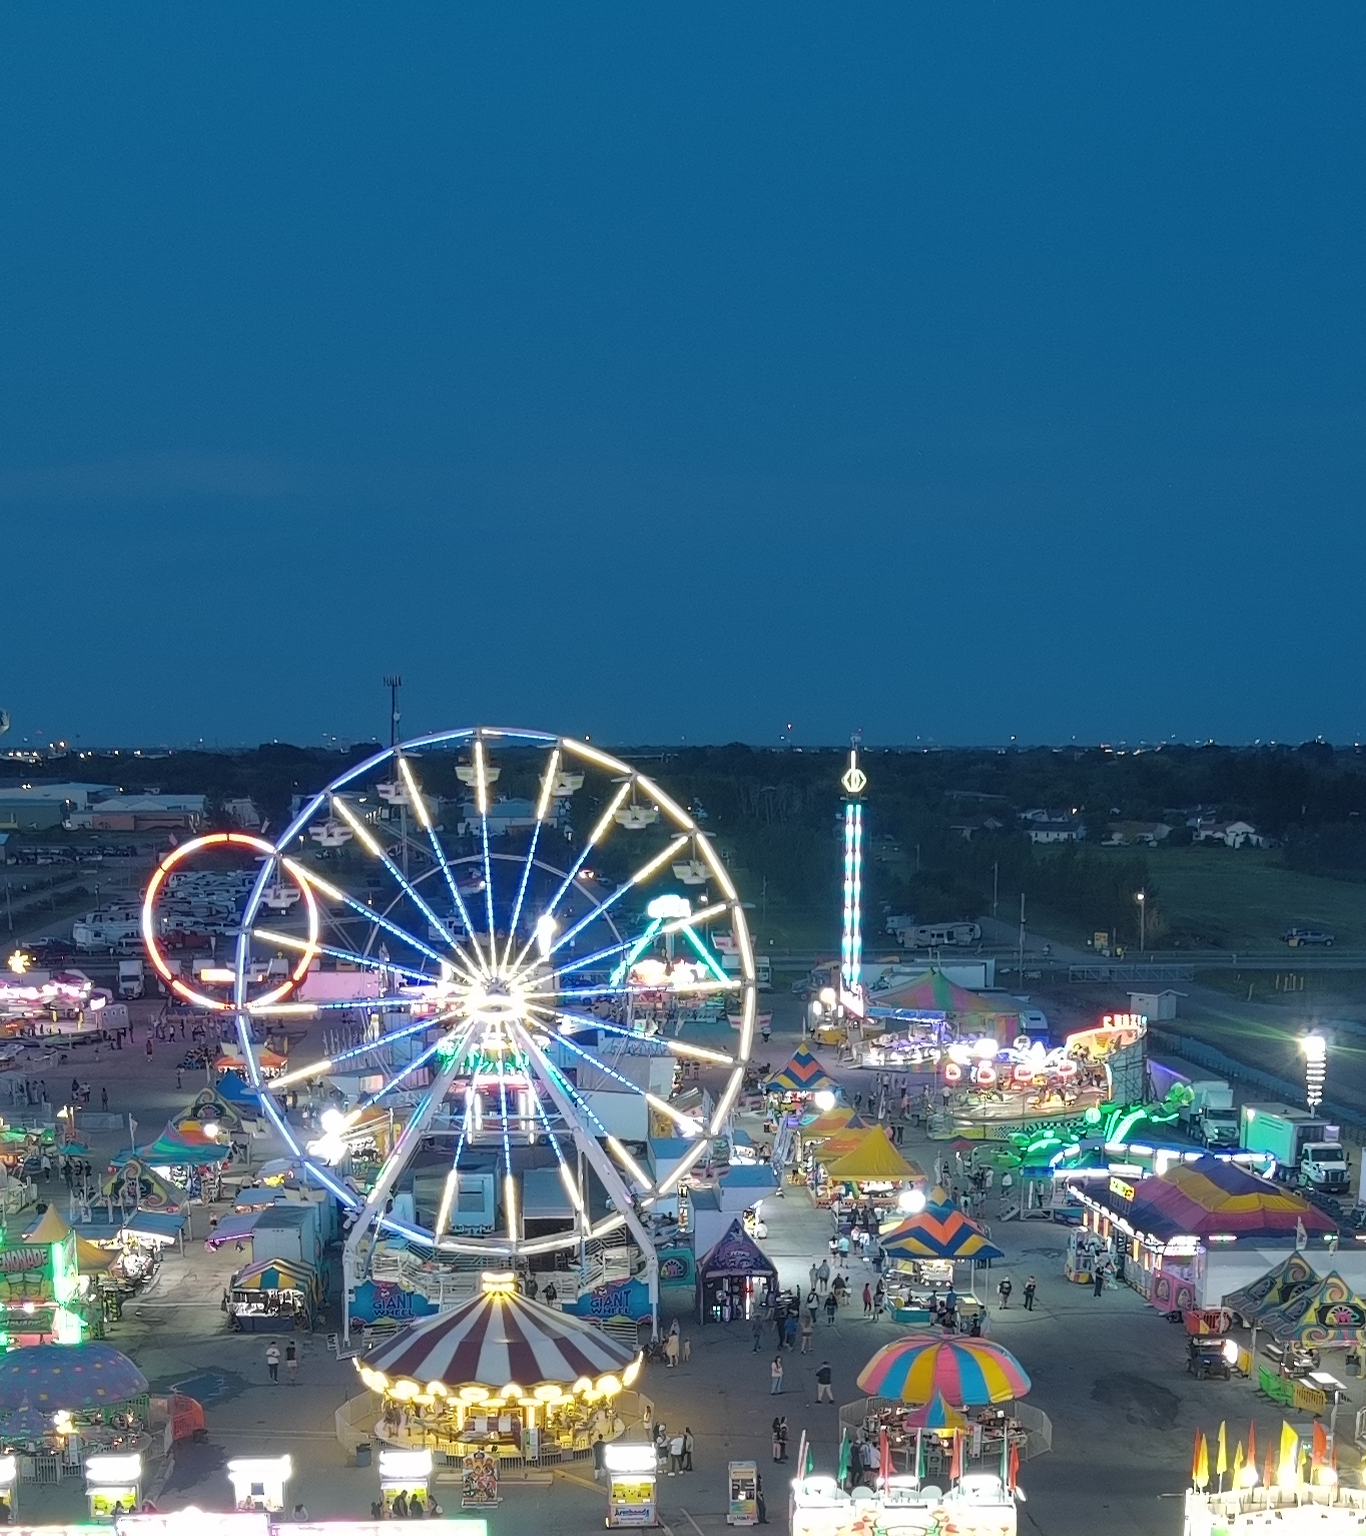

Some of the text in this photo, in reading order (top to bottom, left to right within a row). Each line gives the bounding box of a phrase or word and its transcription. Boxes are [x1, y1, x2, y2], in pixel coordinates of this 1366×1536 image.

[373, 1292, 413, 1309] GIANT
[590, 1291, 632, 1309] GIANT
[374, 1308, 415, 1317] WHEEL
[592, 1307, 632, 1316] WHEEL
